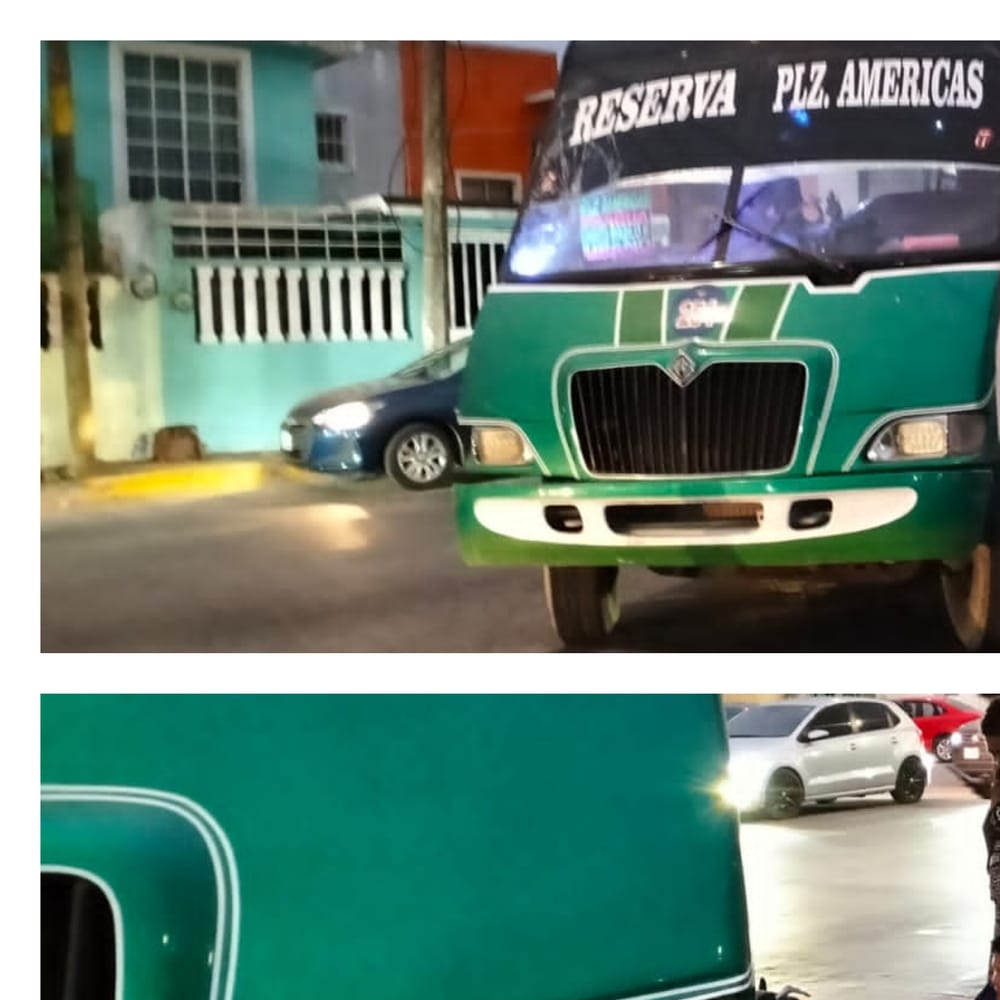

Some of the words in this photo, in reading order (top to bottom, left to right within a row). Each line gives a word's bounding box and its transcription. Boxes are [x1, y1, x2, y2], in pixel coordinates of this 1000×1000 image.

[569, 68, 737, 147] RESERVA
[772, 60, 830, 113] PLZ.
[836, 57, 985, 109] AMERICAS
